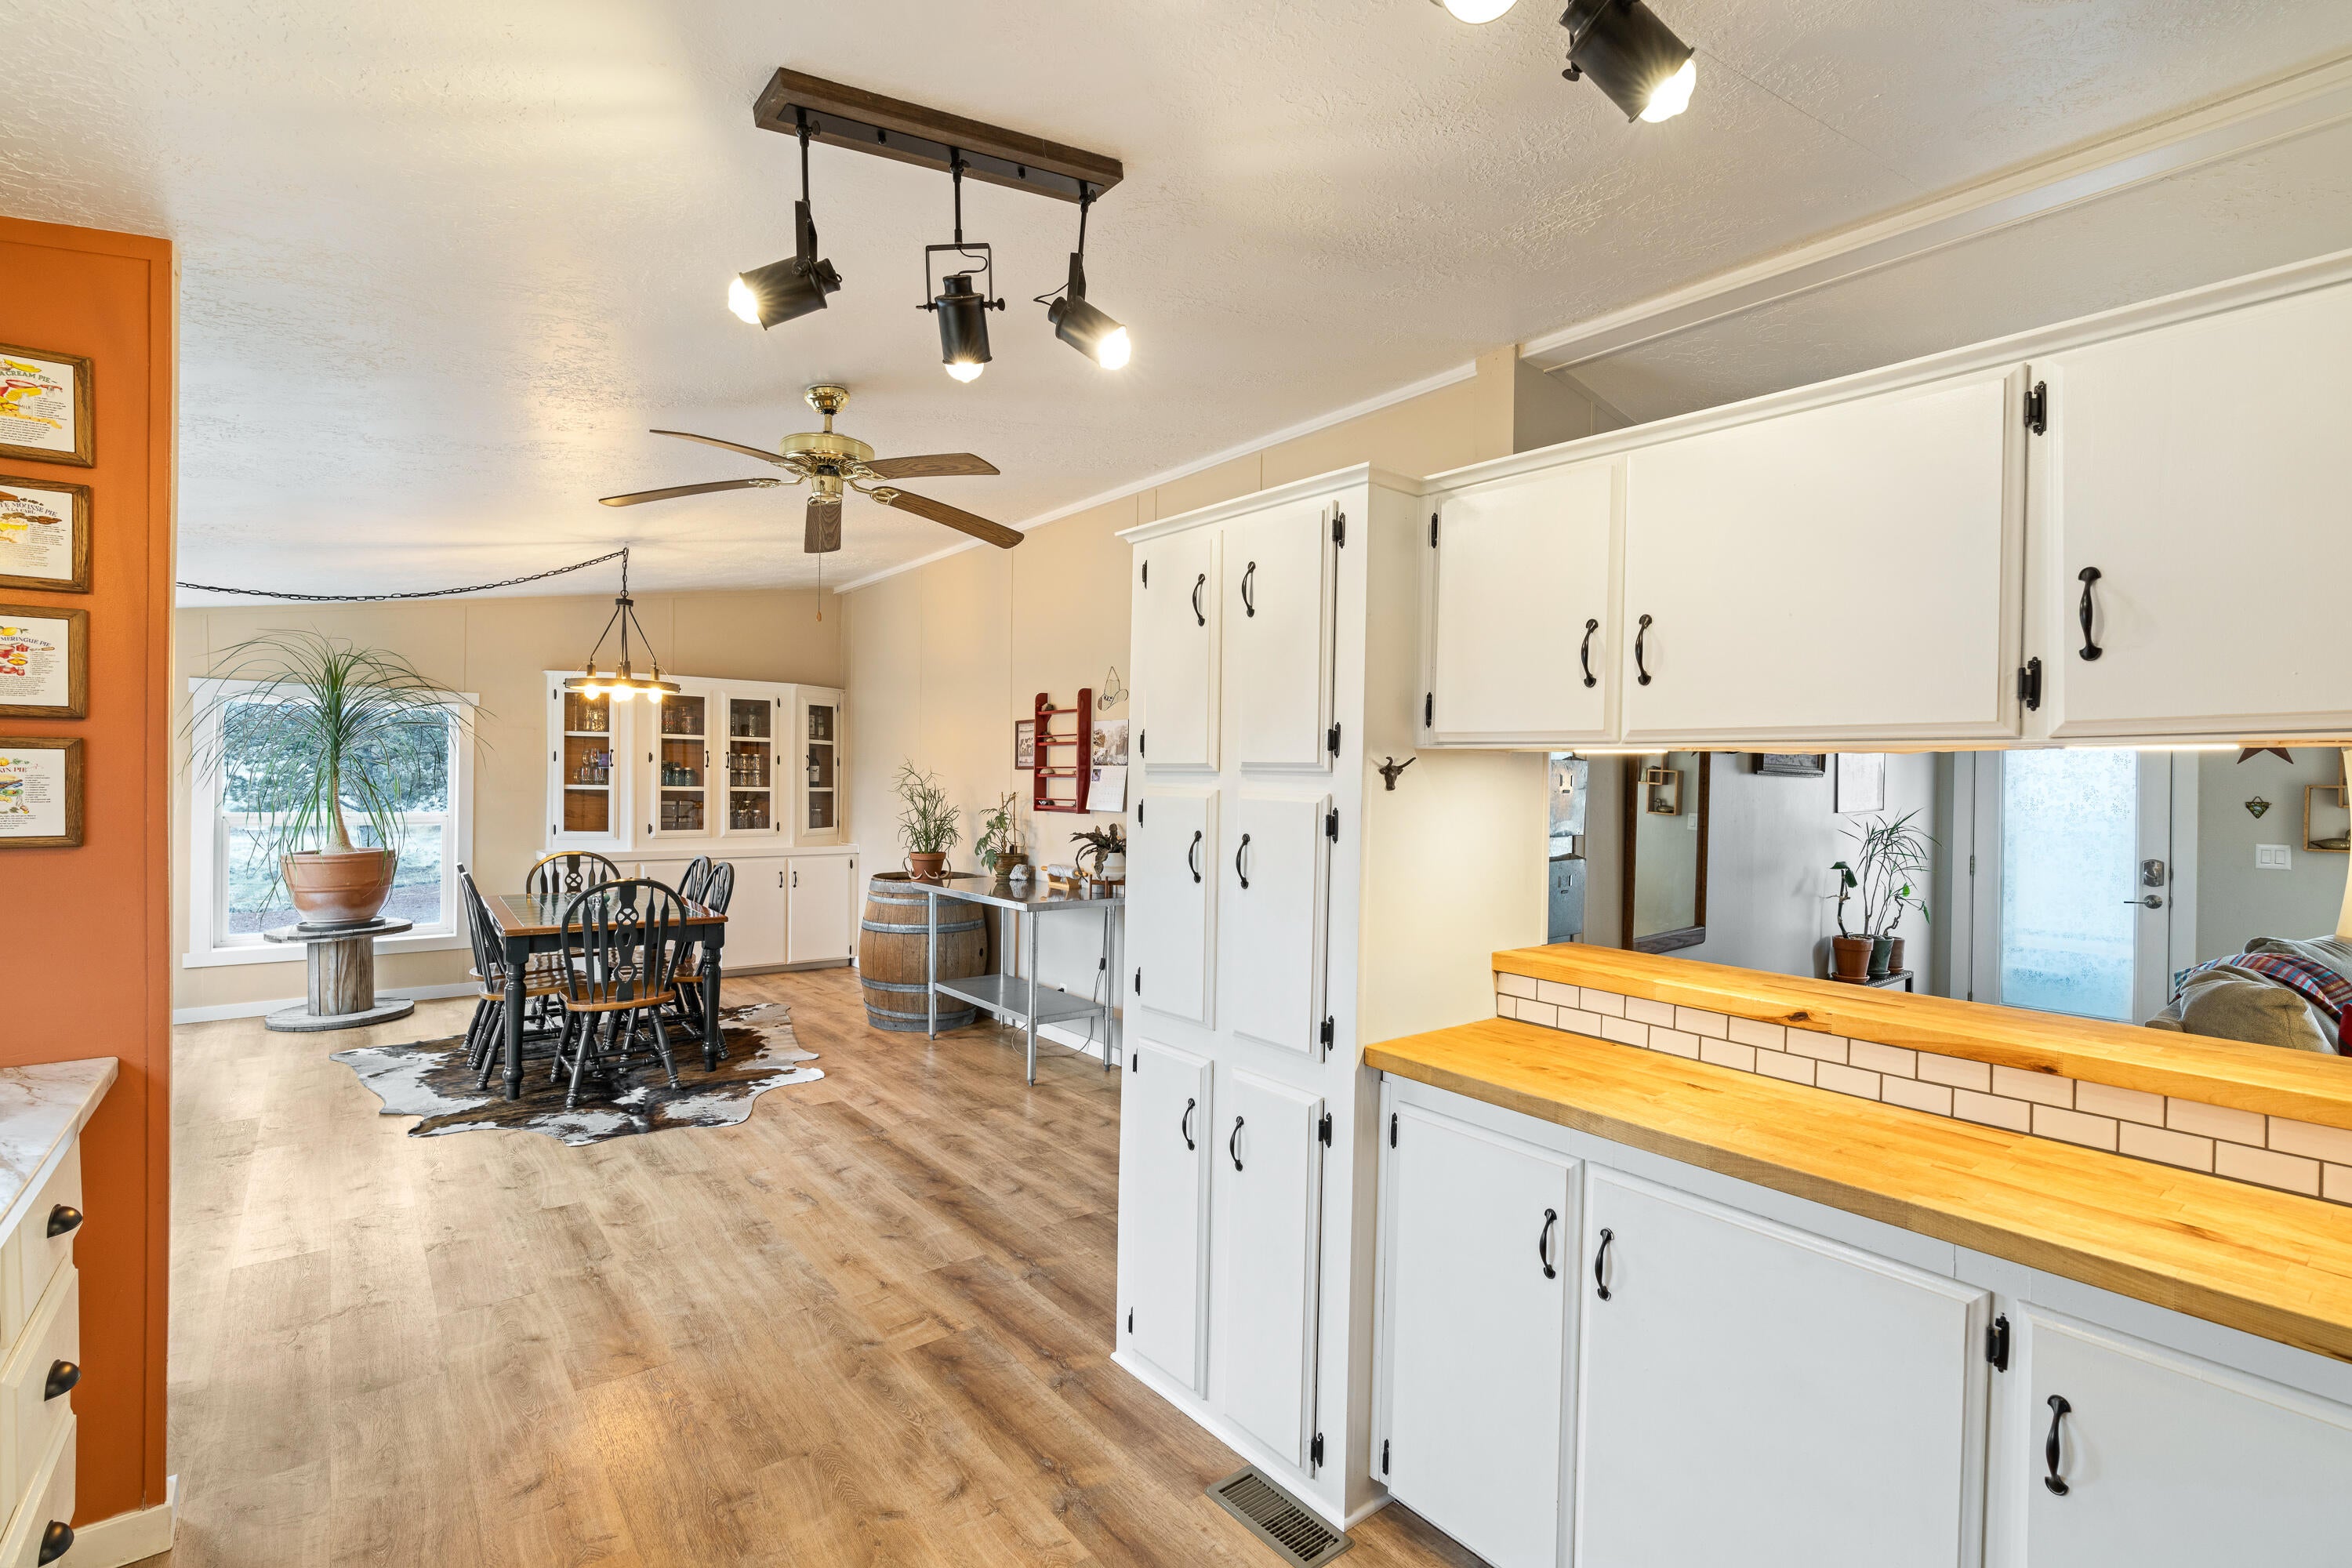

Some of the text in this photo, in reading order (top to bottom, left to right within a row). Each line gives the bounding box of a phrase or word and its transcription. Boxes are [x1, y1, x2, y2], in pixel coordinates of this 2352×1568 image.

[38, 374, 51, 383] PIE
[45, 509, 58, 517] PIE
[0, 636, 38, 644] MERINGUE
